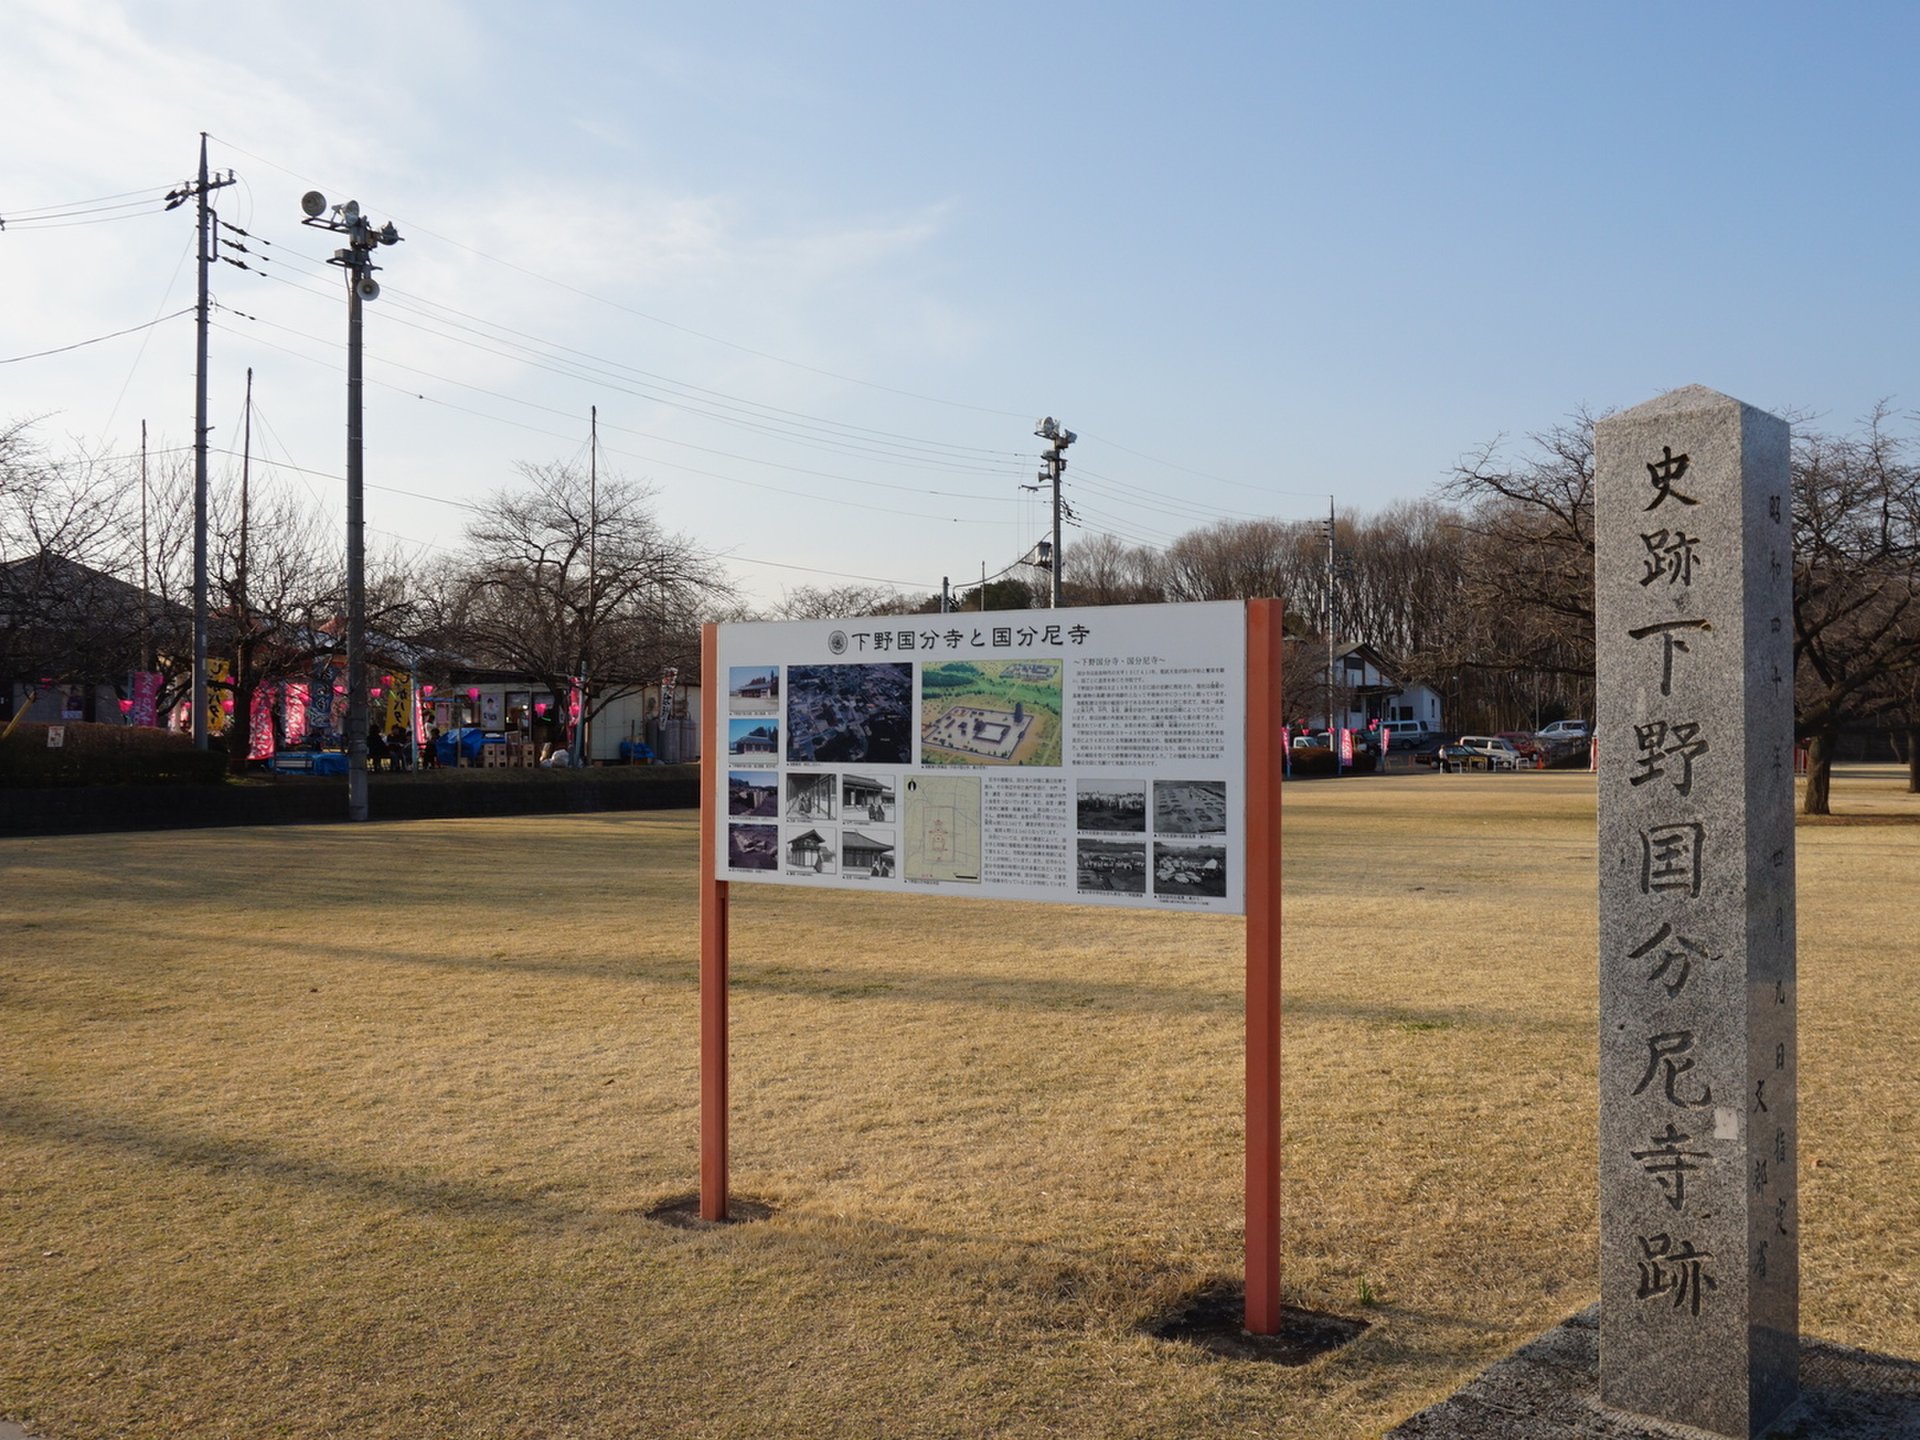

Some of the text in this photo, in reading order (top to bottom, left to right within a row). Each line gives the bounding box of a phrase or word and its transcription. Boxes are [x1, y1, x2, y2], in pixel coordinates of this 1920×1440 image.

[852, 624, 1090, 651] 下野国分寺と国分尼寺
[1769, 495, 1788, 1236] 昭和四十年四月九日指定
[1628, 445, 1717, 1314] 史跡下野国分尼寺跡
[1753, 1079, 1768, 1280] 文部省
